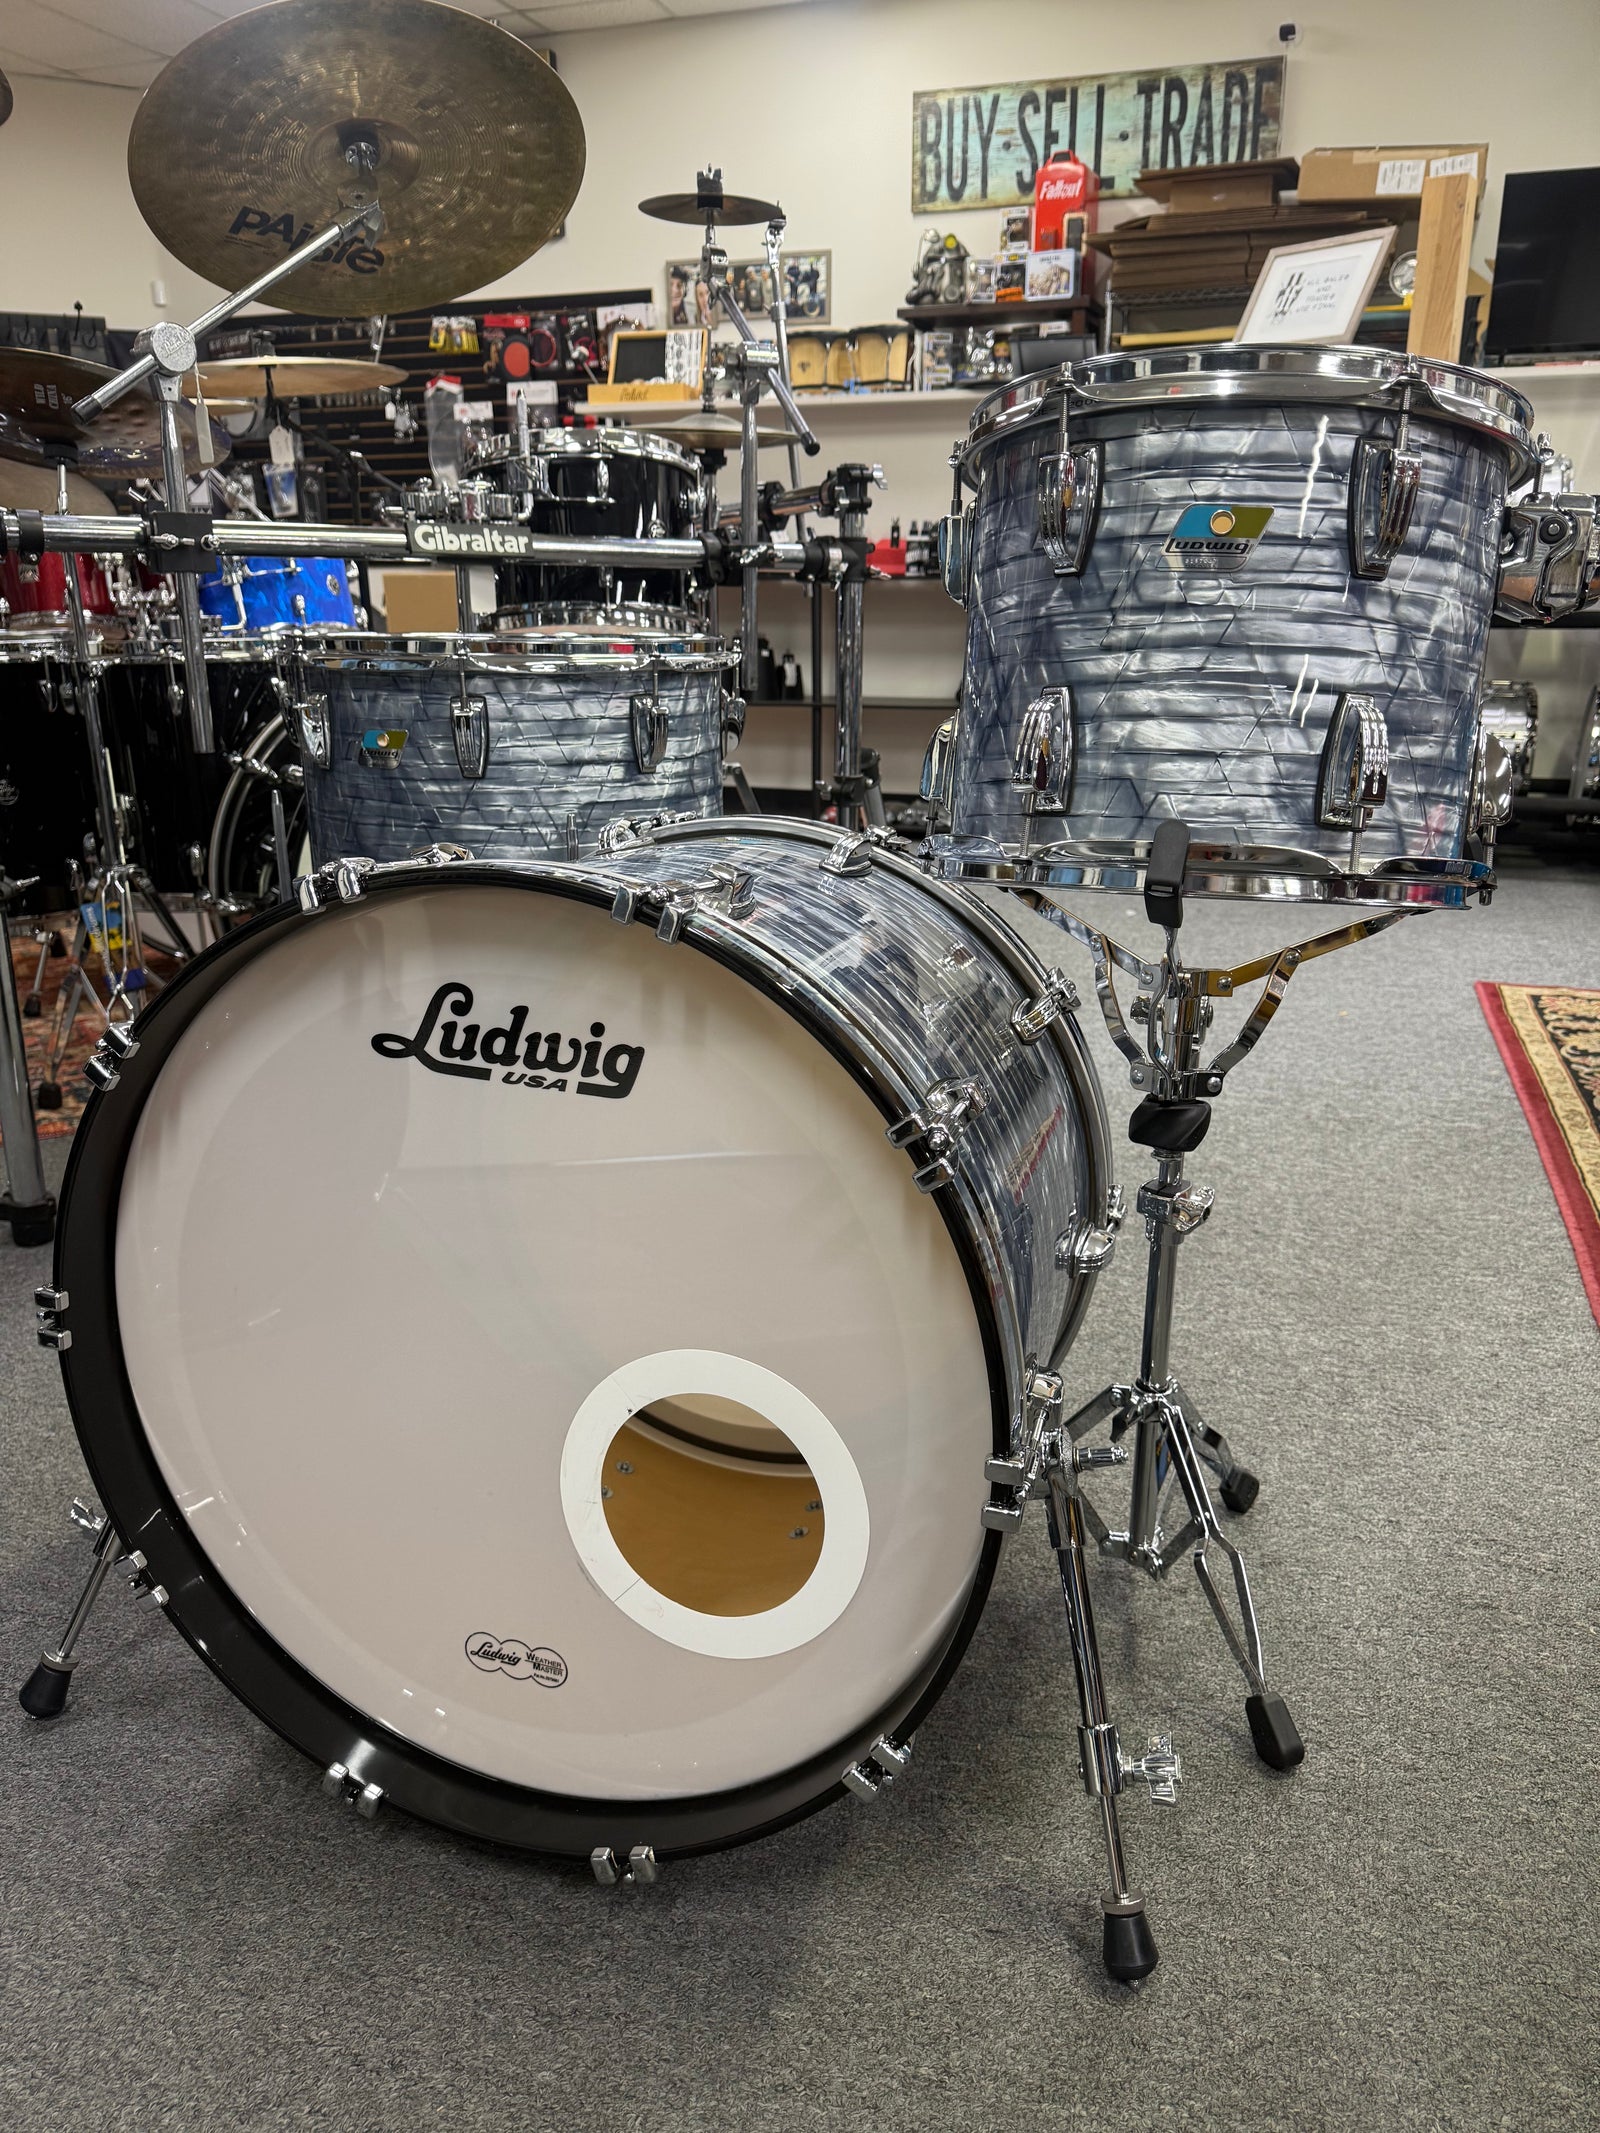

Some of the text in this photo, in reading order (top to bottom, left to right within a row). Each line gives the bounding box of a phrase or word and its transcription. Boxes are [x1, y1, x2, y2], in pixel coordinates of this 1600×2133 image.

[920, 94, 1000, 204] BUY
[1040, 178, 1083, 201] Fallout
[414, 524, 529, 554] Gibraltar
[371, 982, 645, 1099] Ludwig
[502, 1071, 568, 1092] USA
[470, 1641, 521, 1666] Ludwig
